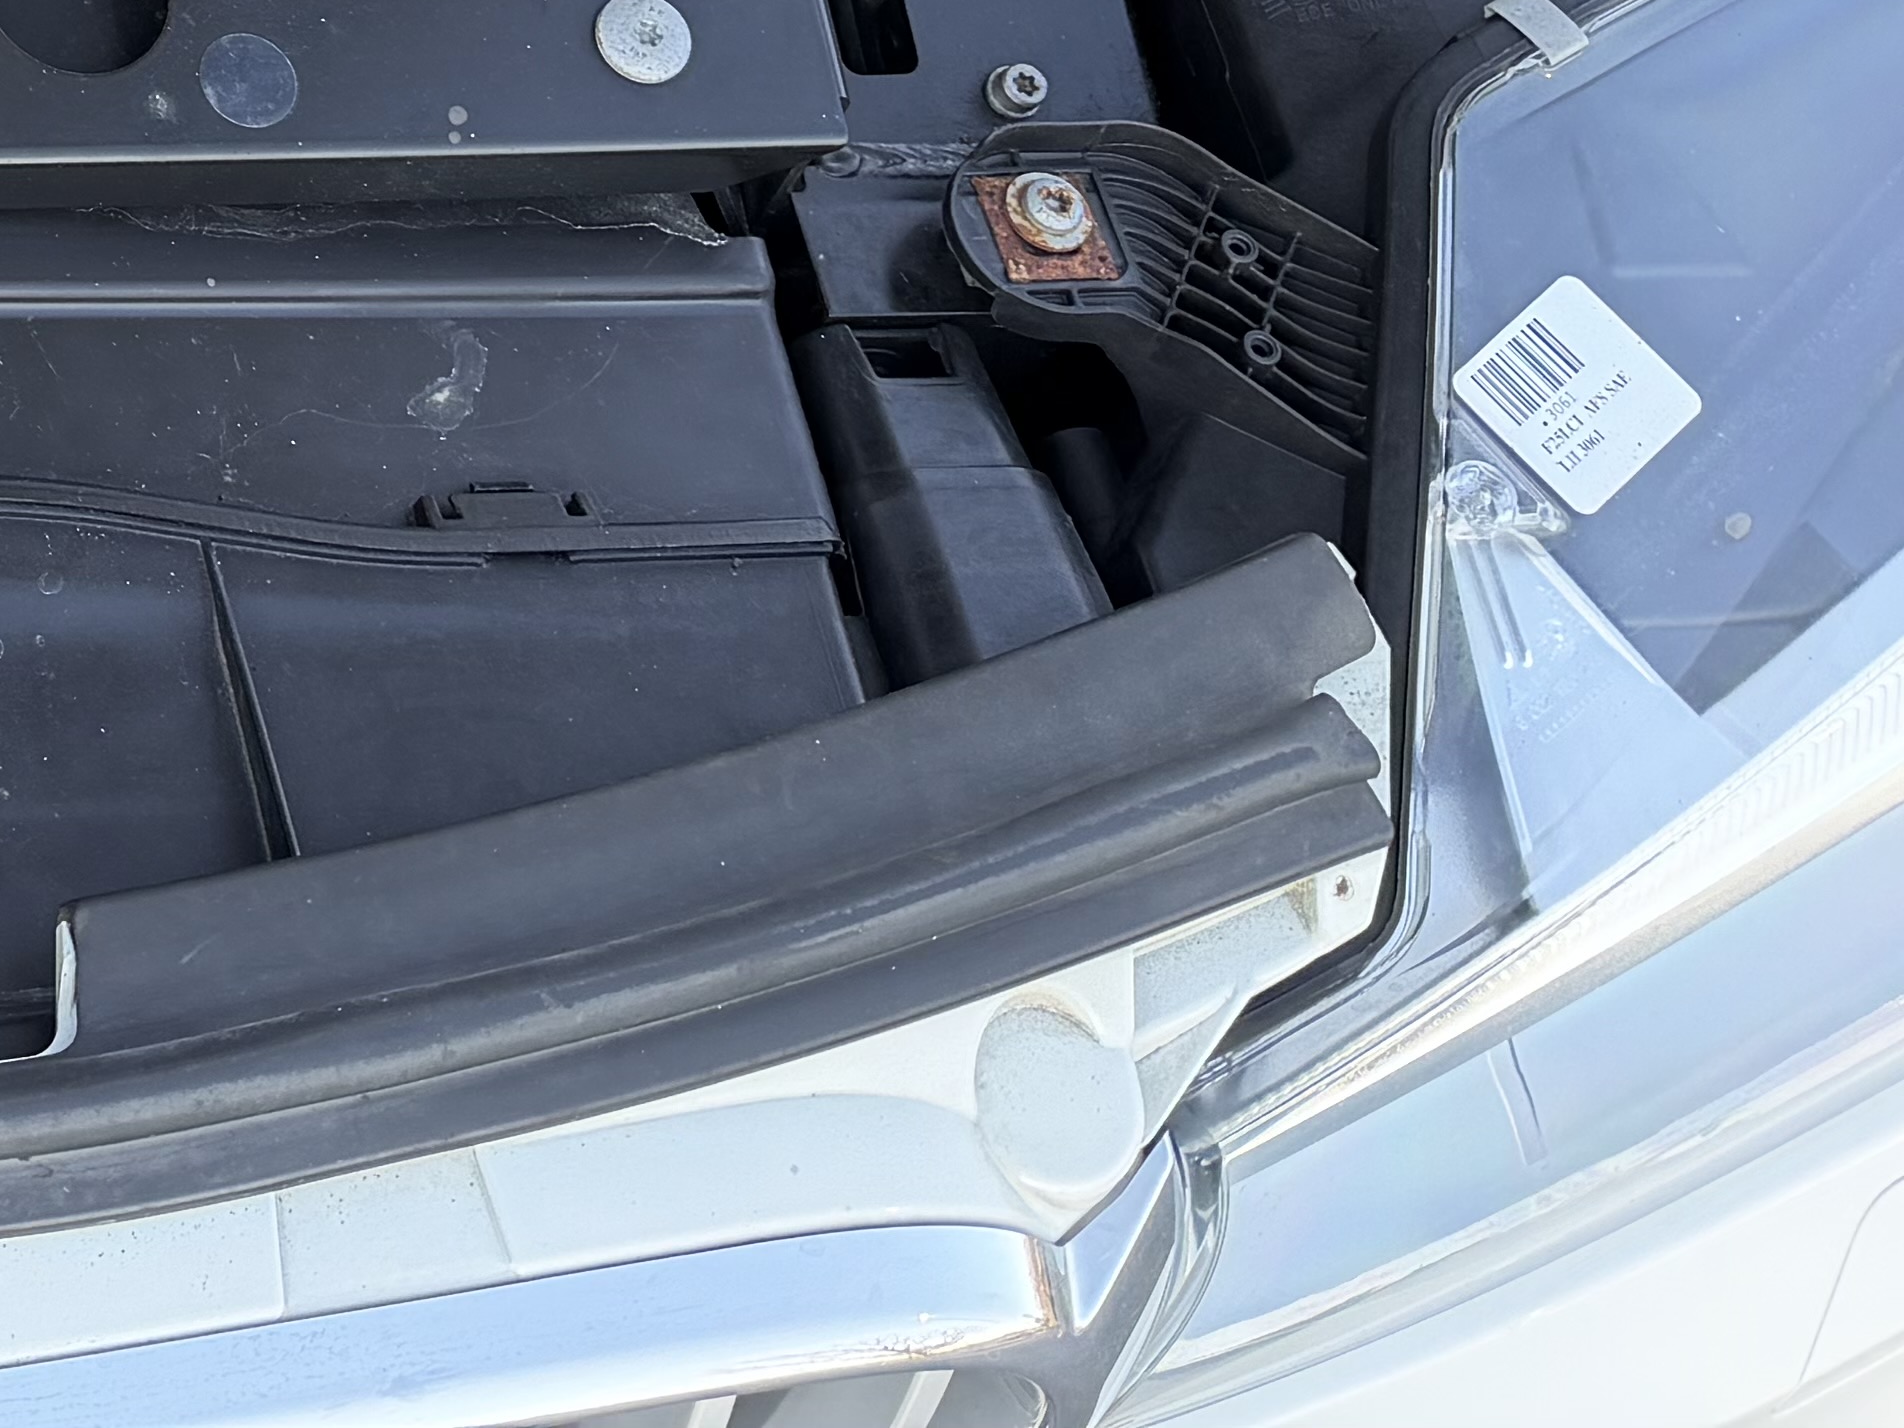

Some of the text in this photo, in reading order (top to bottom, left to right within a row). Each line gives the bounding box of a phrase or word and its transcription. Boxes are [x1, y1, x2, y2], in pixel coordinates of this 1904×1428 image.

[1545, 390, 1578, 422] 3061
[1583, 390, 1610, 418] AFS
[1603, 368, 1634, 398] SAE
[1576, 428, 1606, 458] 3061
